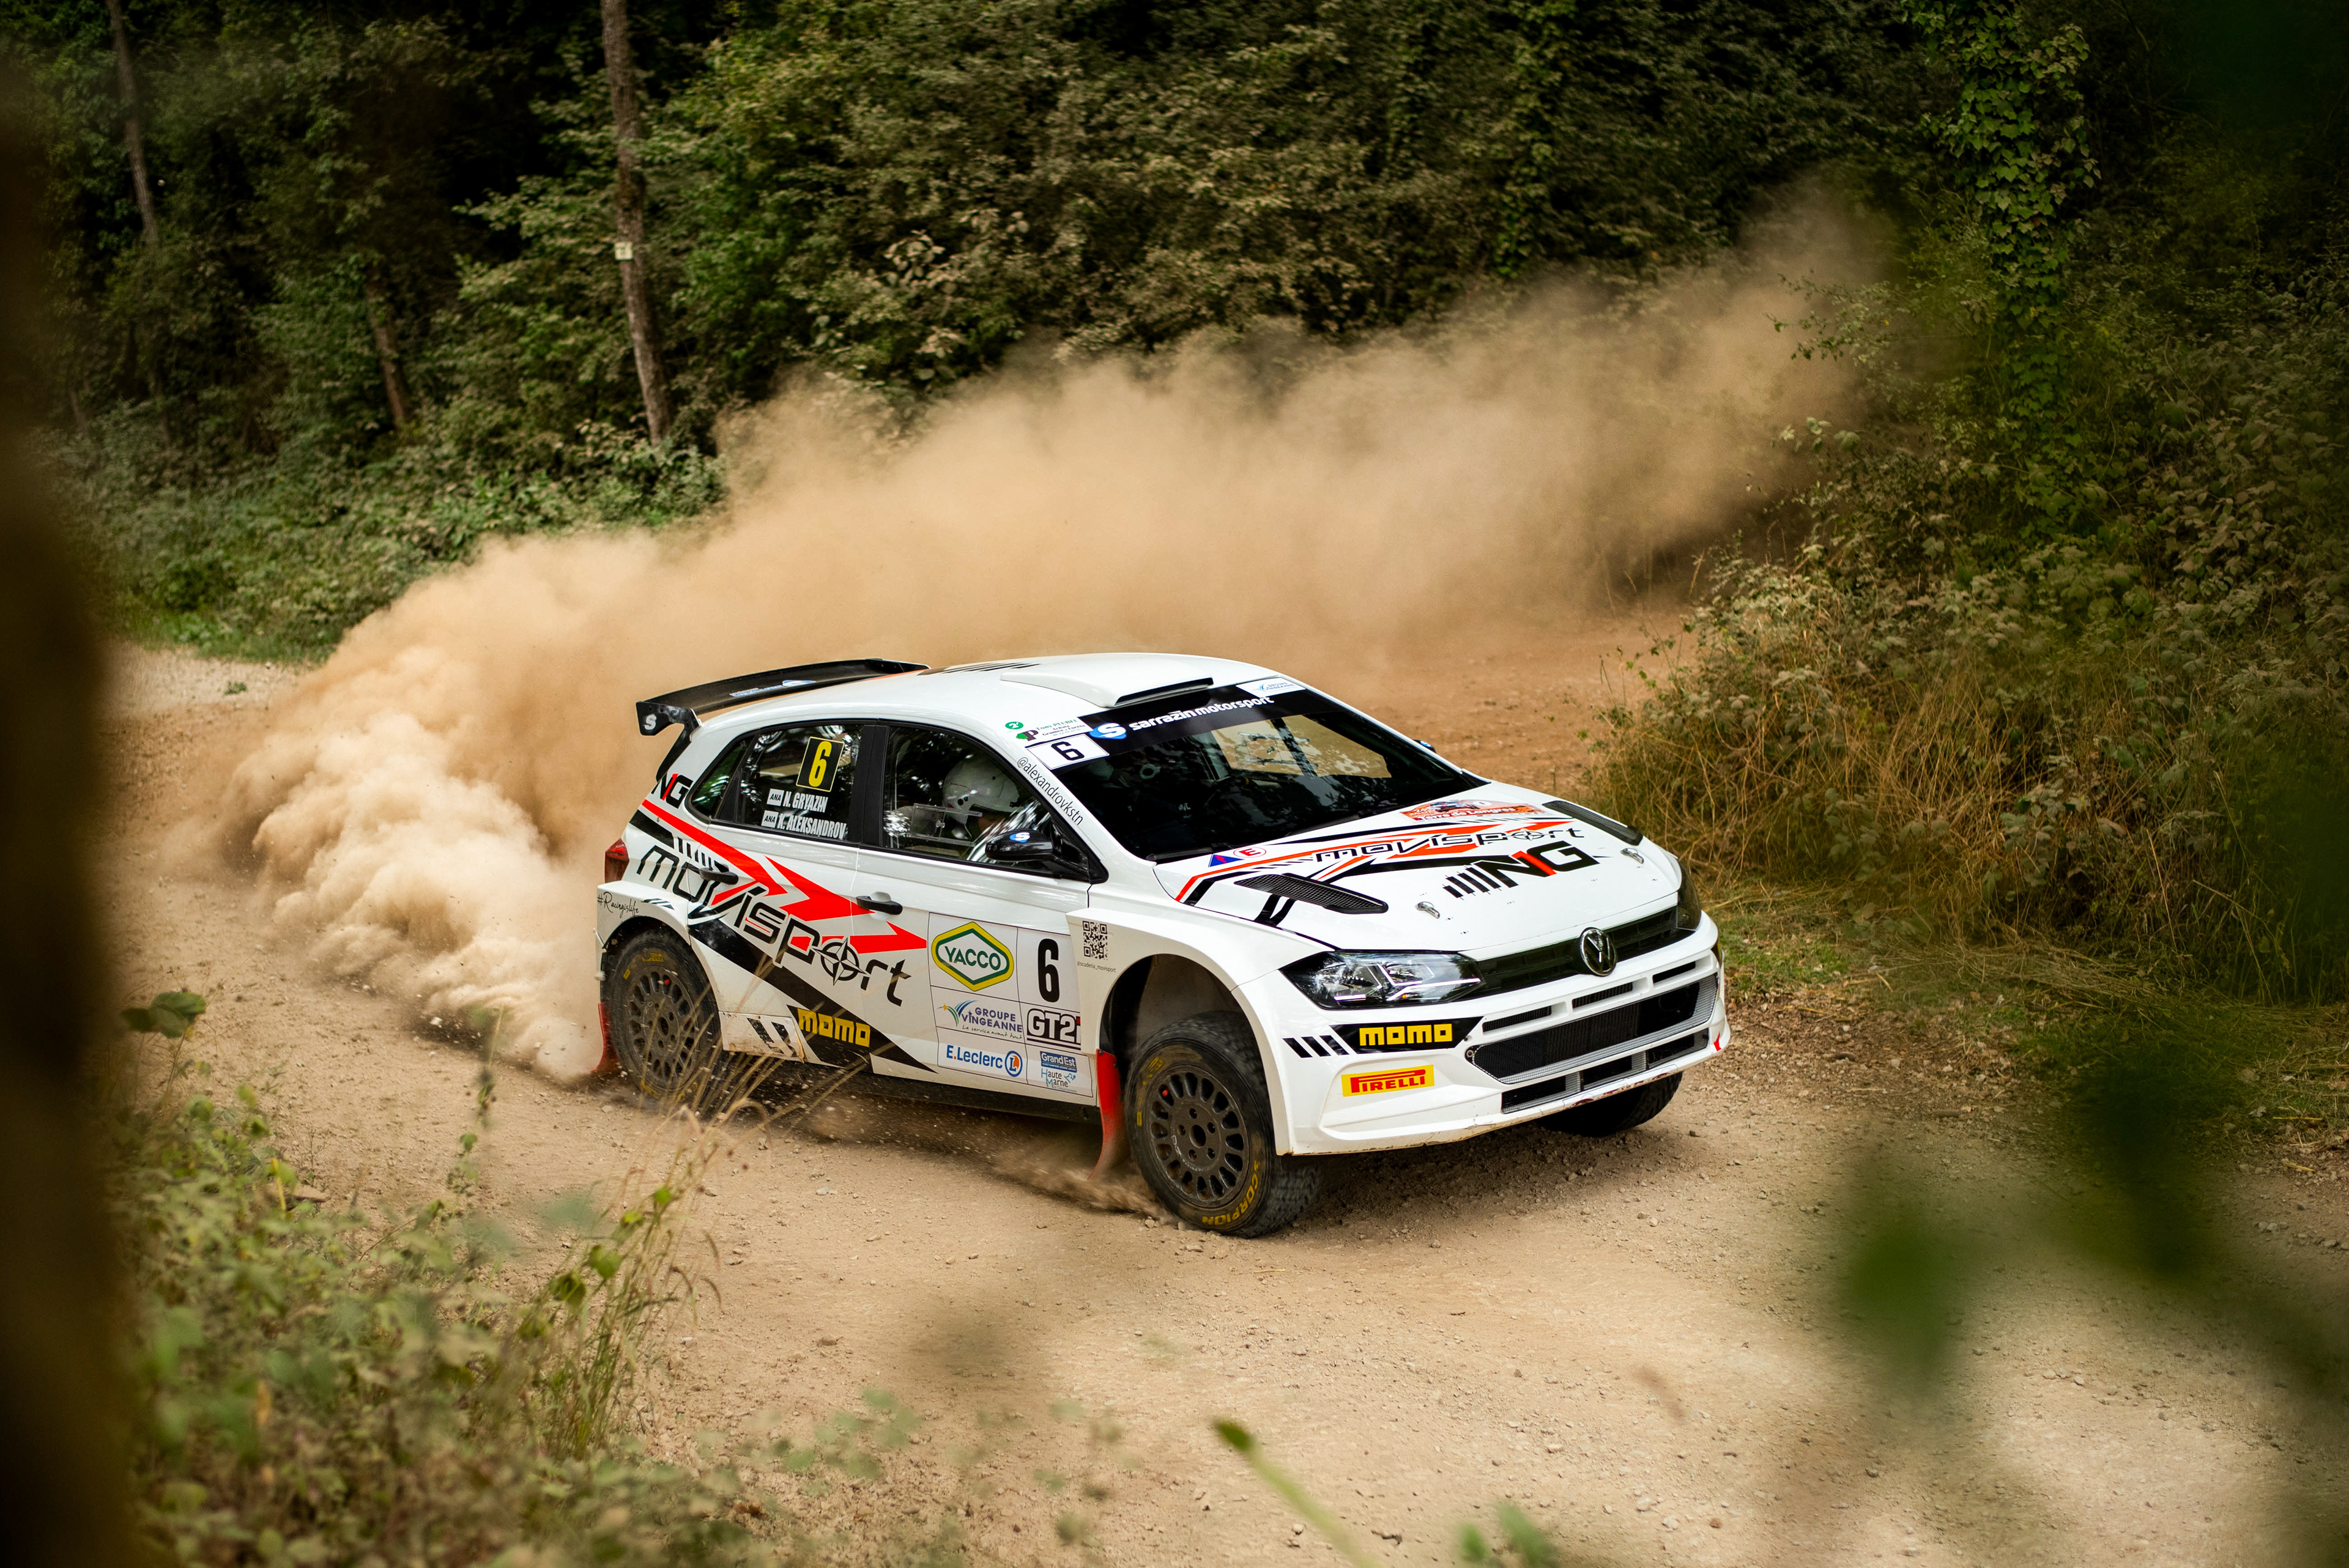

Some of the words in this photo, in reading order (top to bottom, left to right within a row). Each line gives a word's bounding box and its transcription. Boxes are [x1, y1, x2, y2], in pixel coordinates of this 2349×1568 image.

[644, 714, 657, 730] S
[1129, 710, 1197, 731] sarrazin
[1195, 697, 1275, 716] motorsport
[1051, 741, 1085, 761] 6
[809, 741, 832, 787] 6
[770, 793, 781, 802] ANA
[782, 791, 792, 808] N.
[792, 793, 828, 813] GRYAZIN
[1017, 757, 1083, 825] @alexandrovkstn
[786, 815, 847, 840] ALEKSANDROV
[944, 946, 1001, 971] YACCO
[1037, 938, 1060, 1003] 6
[962, 1013, 1022, 1033] VINGEANNE
[975, 1007, 1016, 1022] GROUPE
[946, 1045, 1003, 1069] E.Leclerc
[1041, 1068, 1062, 1079] Haute
[1046, 1078, 1069, 1089] Marne
[1350, 1069, 1426, 1093] PIRELLI
